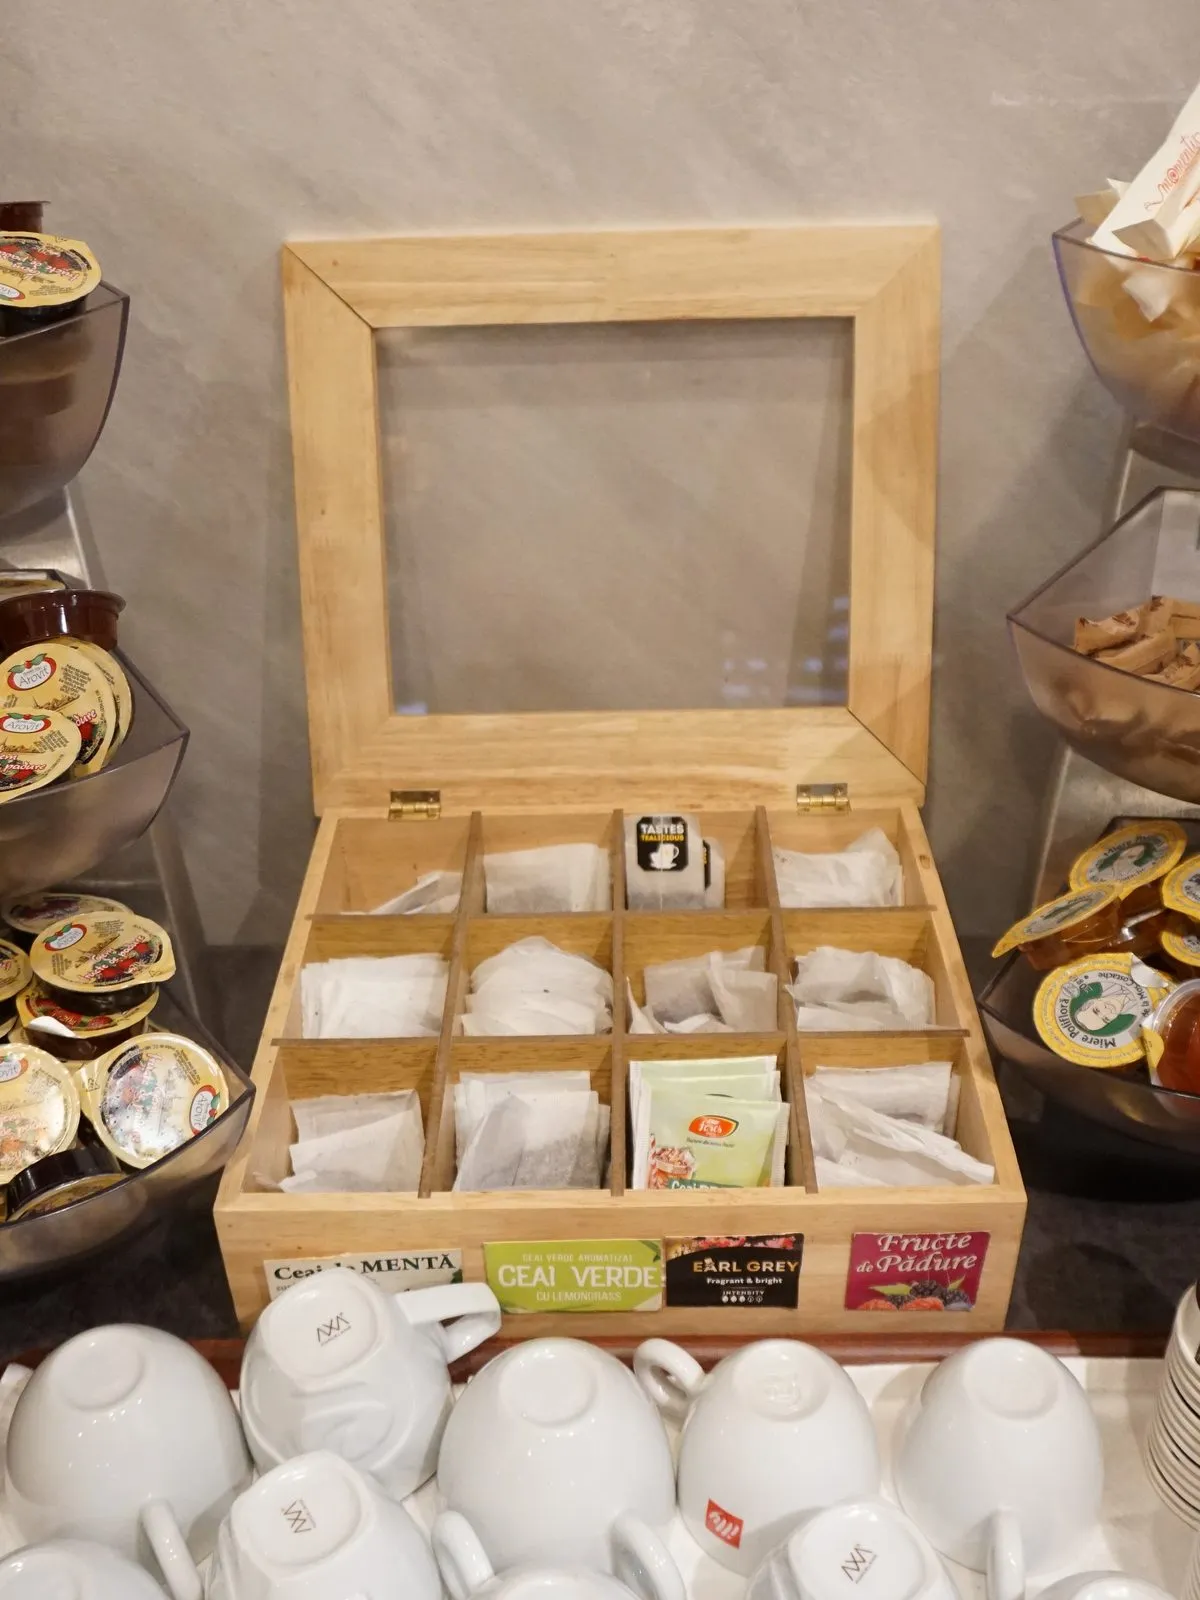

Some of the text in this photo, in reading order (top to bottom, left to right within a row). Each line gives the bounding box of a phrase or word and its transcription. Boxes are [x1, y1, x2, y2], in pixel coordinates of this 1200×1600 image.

[19, 666, 49, 686] Arovit
[6, 721, 42, 731] Arovit
[640, 823, 685, 834] TASTES
[1082, 1034, 1117, 1049] Miere
[878, 1233, 973, 1252] Fructe
[360, 1253, 456, 1275] MENTĂ
[547, 1253, 574, 1262] VERDE
[578, 1253, 633, 1262] AROMATIZAT
[856, 1251, 978, 1273] de Pădure
[693, 1259, 799, 1273] EARL GREY
[498, 1264, 660, 1288] CEAI VERDE
[707, 1277, 744, 1286] Fragrant
[755, 1277, 783, 1286] bright
[536, 1291, 622, 1302] CU LEMONGRASS
[709, 1510, 740, 1541] illy
